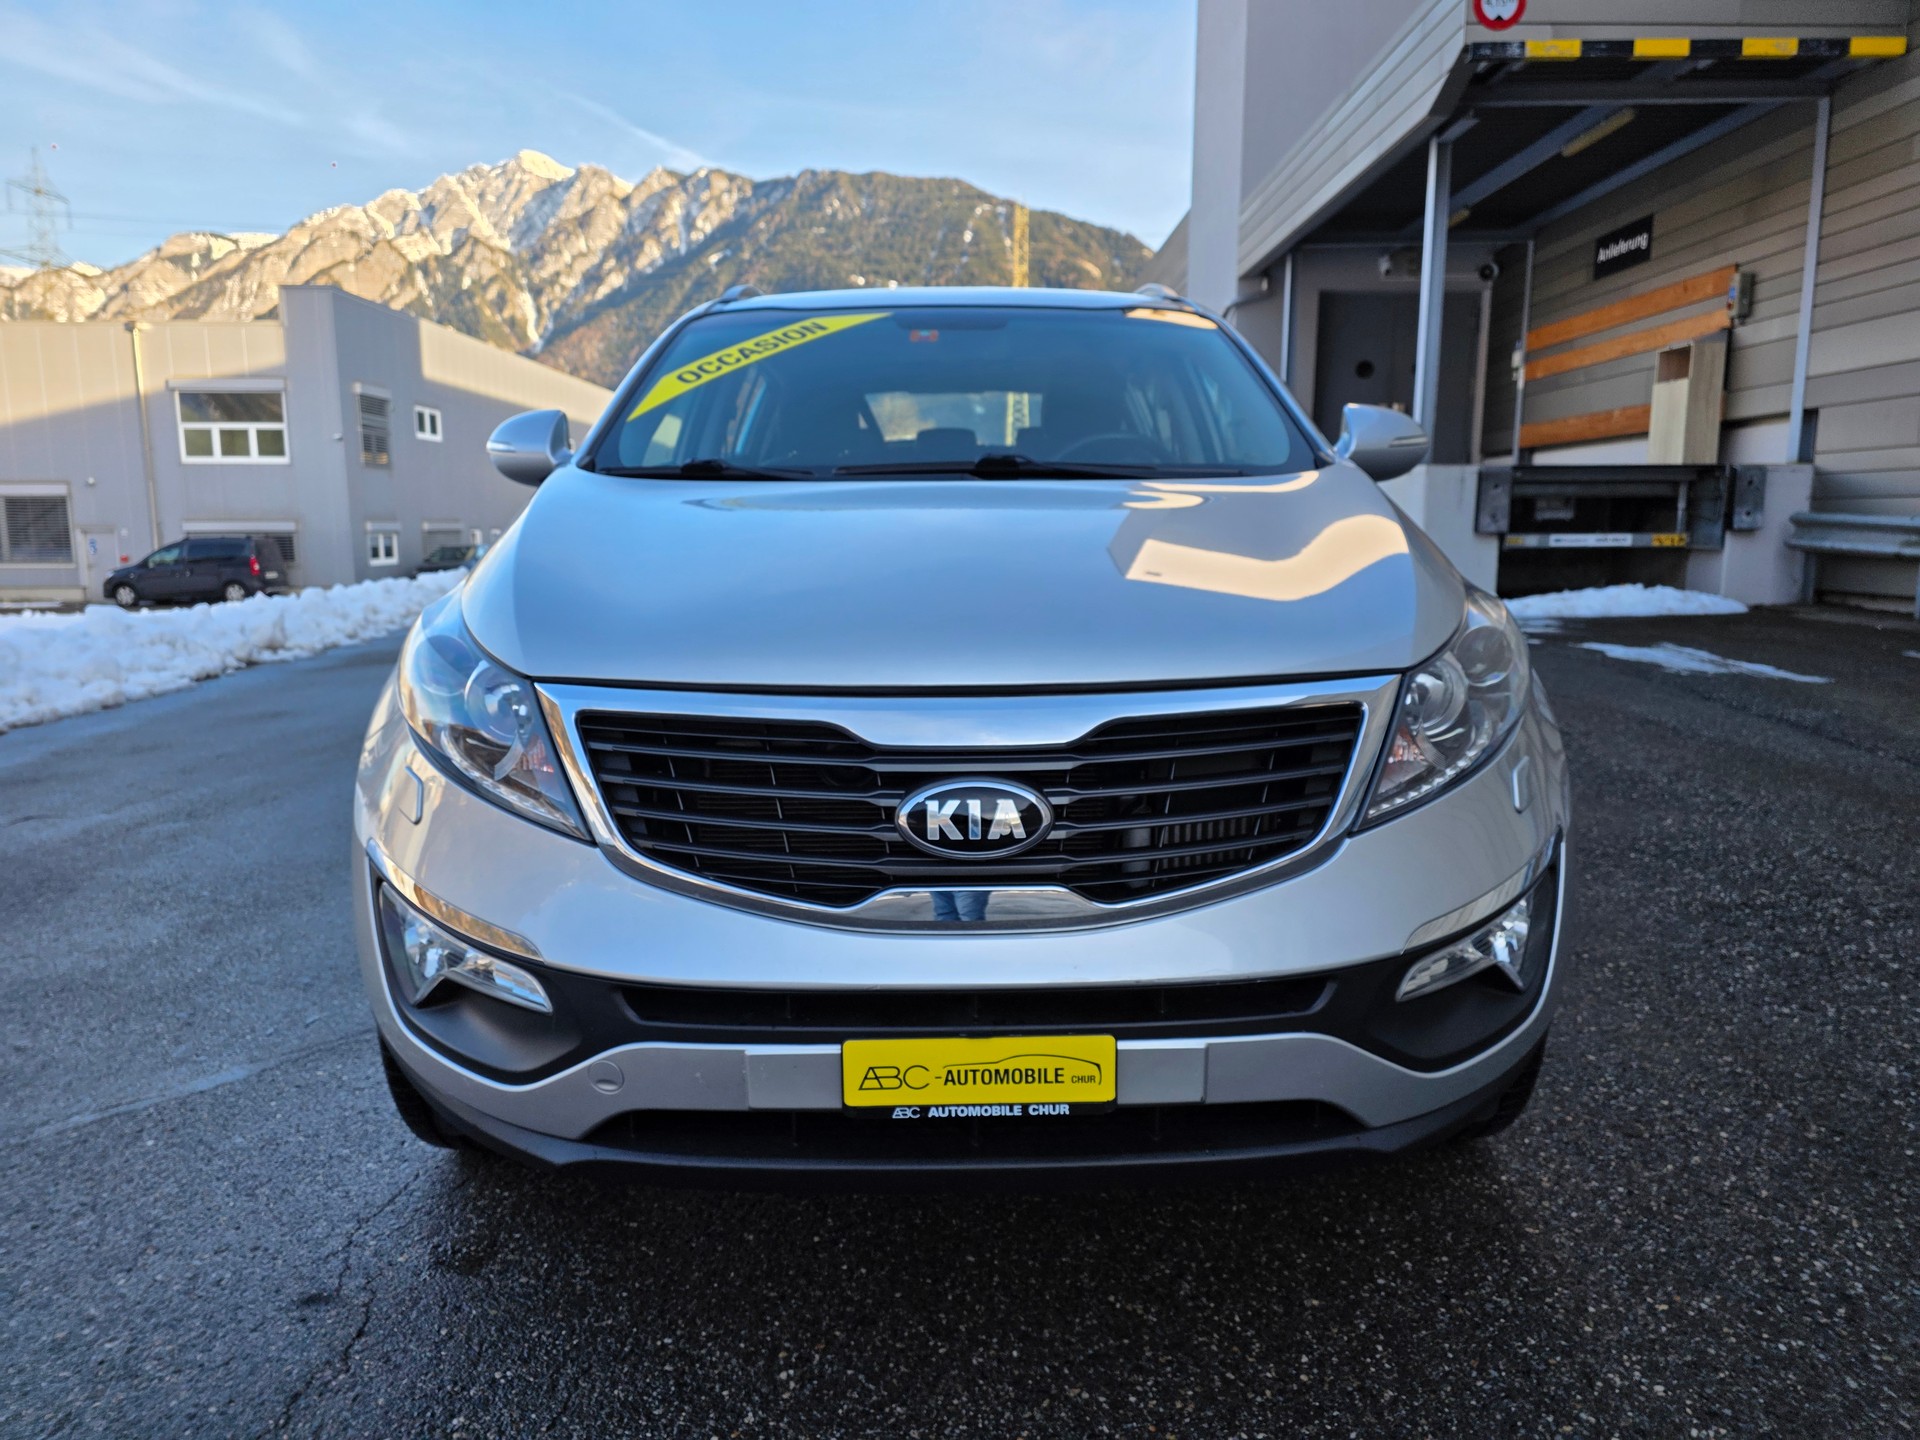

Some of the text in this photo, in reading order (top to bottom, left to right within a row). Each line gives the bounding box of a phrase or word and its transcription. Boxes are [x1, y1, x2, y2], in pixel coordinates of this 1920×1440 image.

[676, 321, 829, 384] OCCASION
[925, 798, 1027, 840] KIA
[858, 1064, 931, 1091] ABC
[1071, 1075, 1097, 1084] CHUR
[892, 1104, 1070, 1119] ABC AUTOMOBILE CHUR
